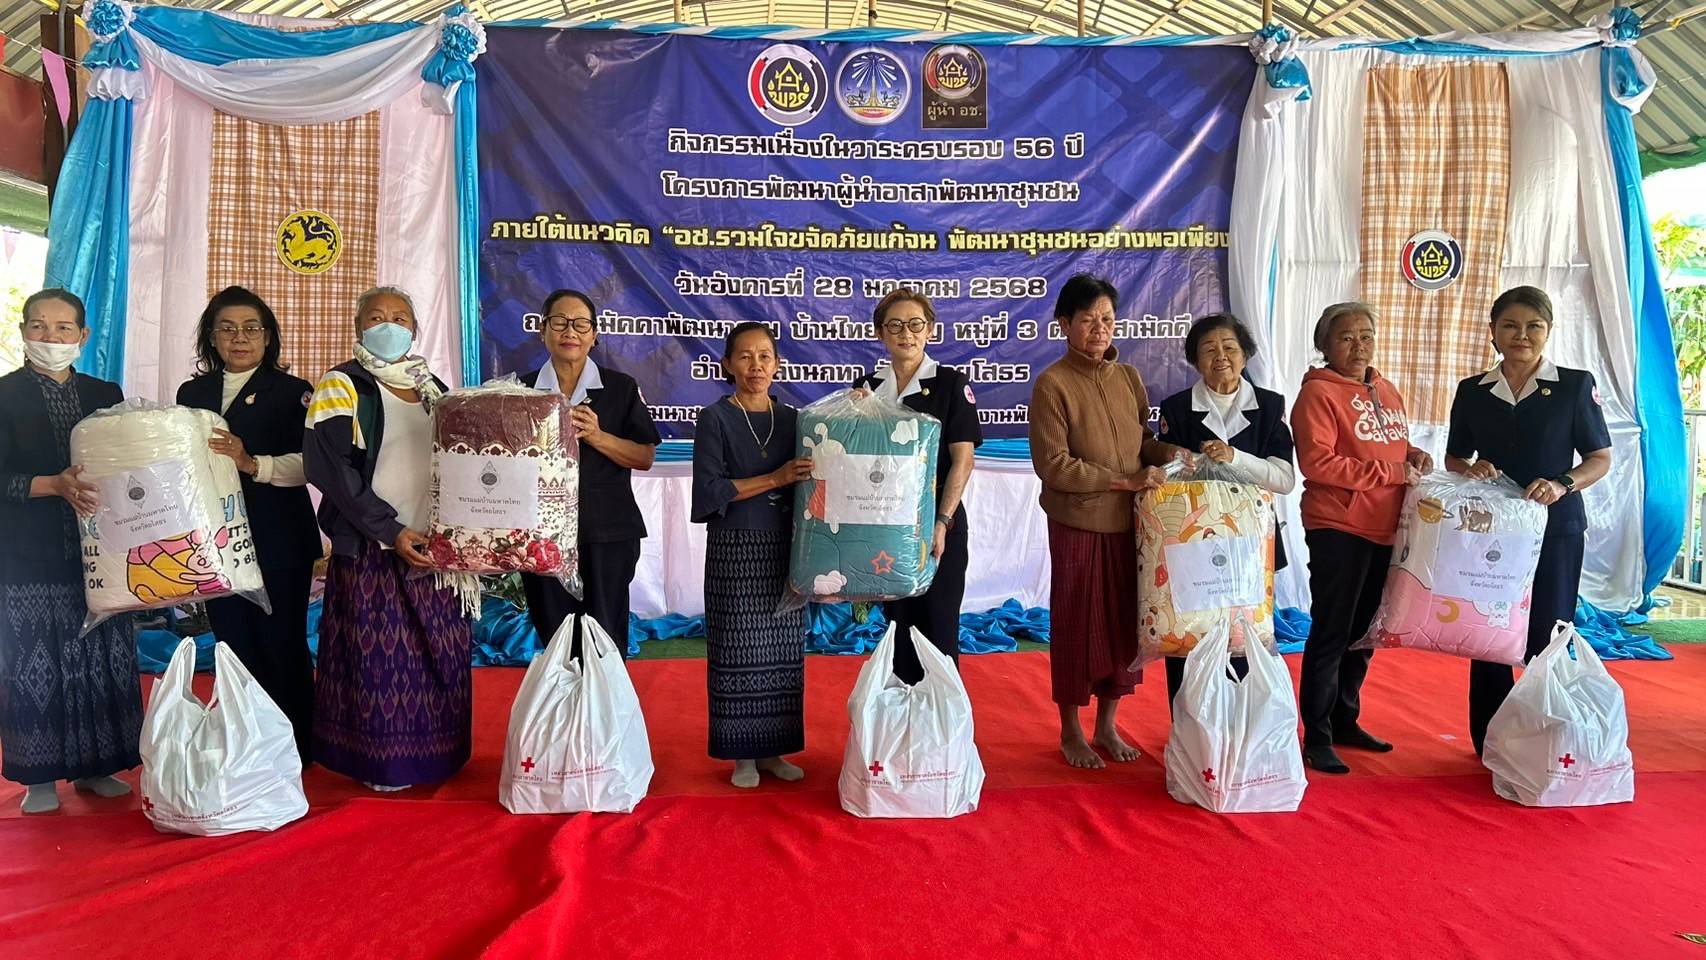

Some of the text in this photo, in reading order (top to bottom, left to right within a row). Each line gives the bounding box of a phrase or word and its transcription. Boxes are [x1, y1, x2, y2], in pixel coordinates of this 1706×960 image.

[927, 101, 983, 121] ผู้นำ อช.
[668, 128, 1085, 160] กิจกรรมเนื่องในวาระครบรอบ 56 ปี
[660, 172, 1081, 208] โครงการพัฒนาผู้นำอาสาพัฒนาชุมชน
[490, 214, 651, 246] ภายใต้แนวคิด
[673, 267, 804, 298] วันอังคารที่
[813, 276, 854, 299] 28
[969, 275, 1048, 299] 2568
[954, 311, 1008, 348] หมู่ที่
[1016, 320, 1038, 340] 3
[88, 578, 104, 589] OK
